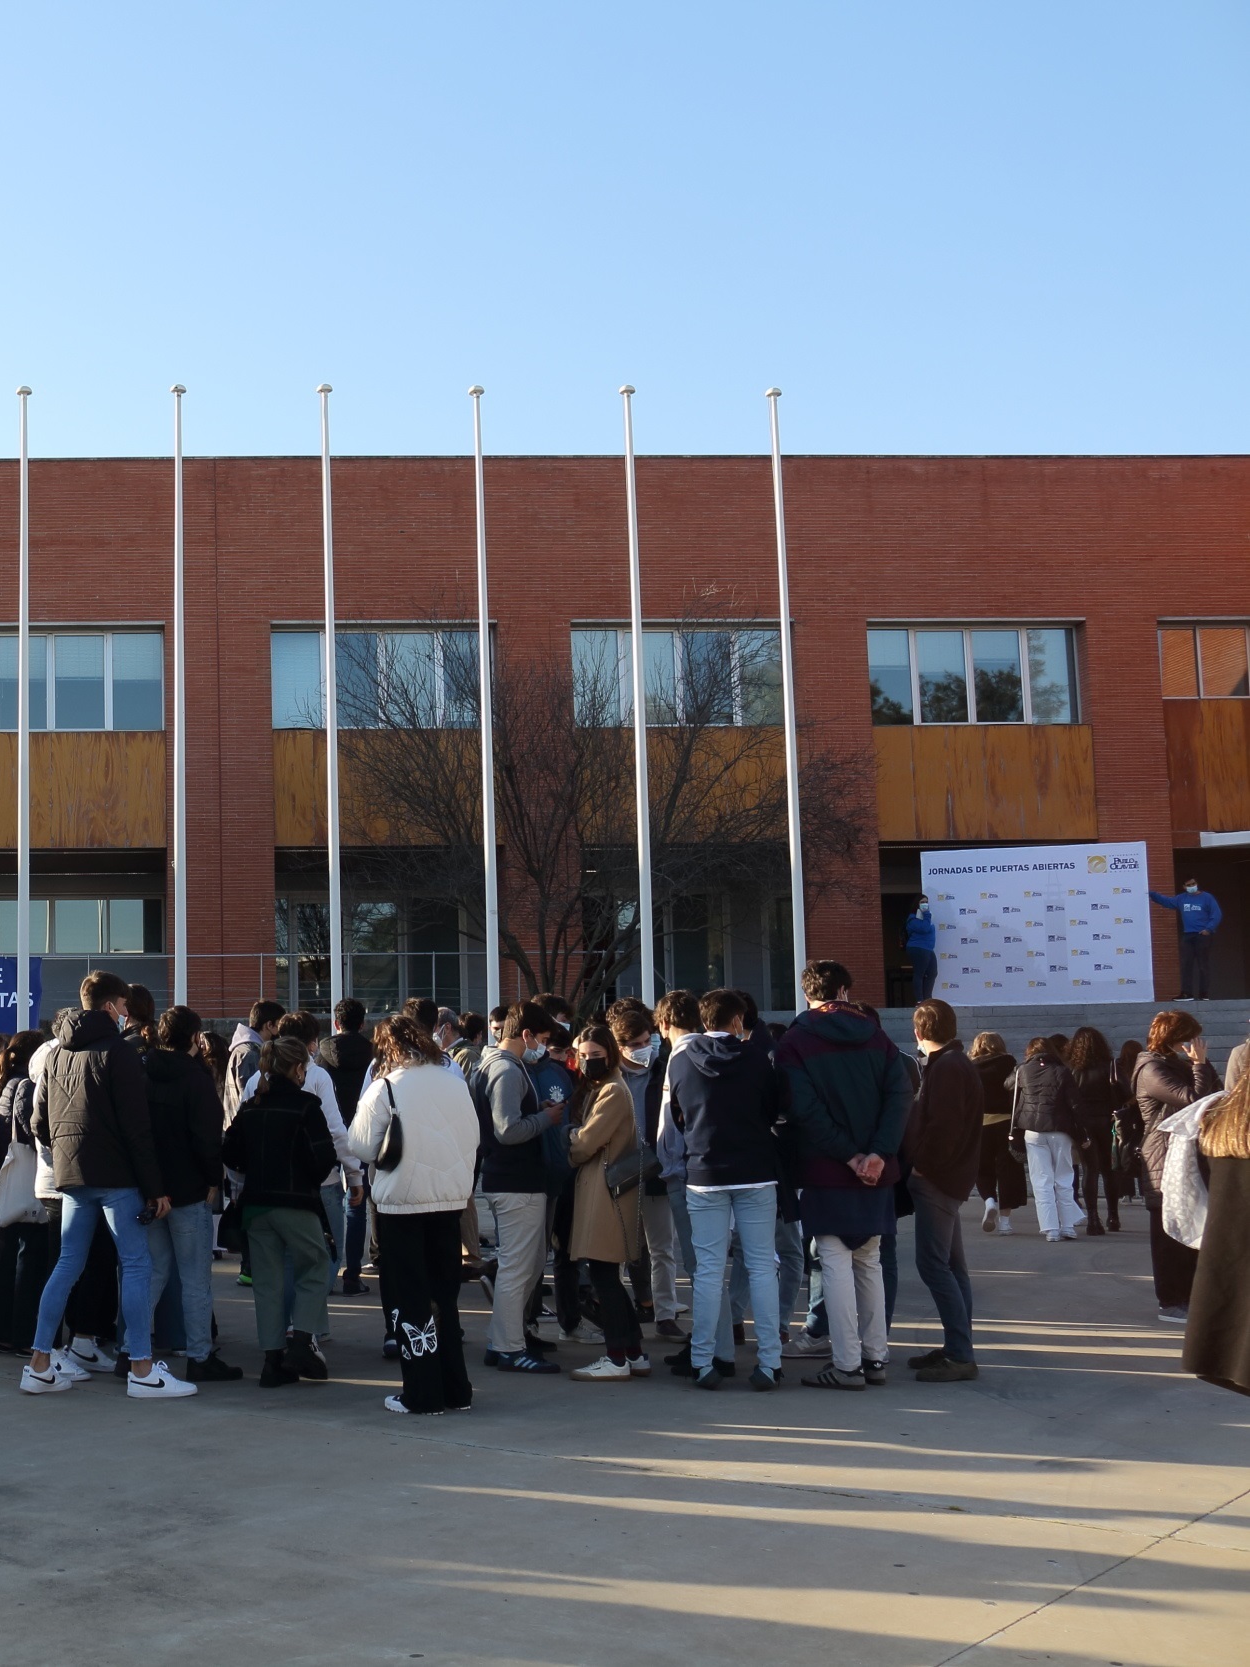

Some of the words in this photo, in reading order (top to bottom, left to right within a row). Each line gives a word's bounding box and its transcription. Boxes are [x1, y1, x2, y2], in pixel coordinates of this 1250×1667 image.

[928, 866, 973, 875] JORNADAS
[975, 865, 988, 873] DE
[990, 864, 1030, 873] PUERTAS
[1032, 862, 1076, 871] ABIERTAS
